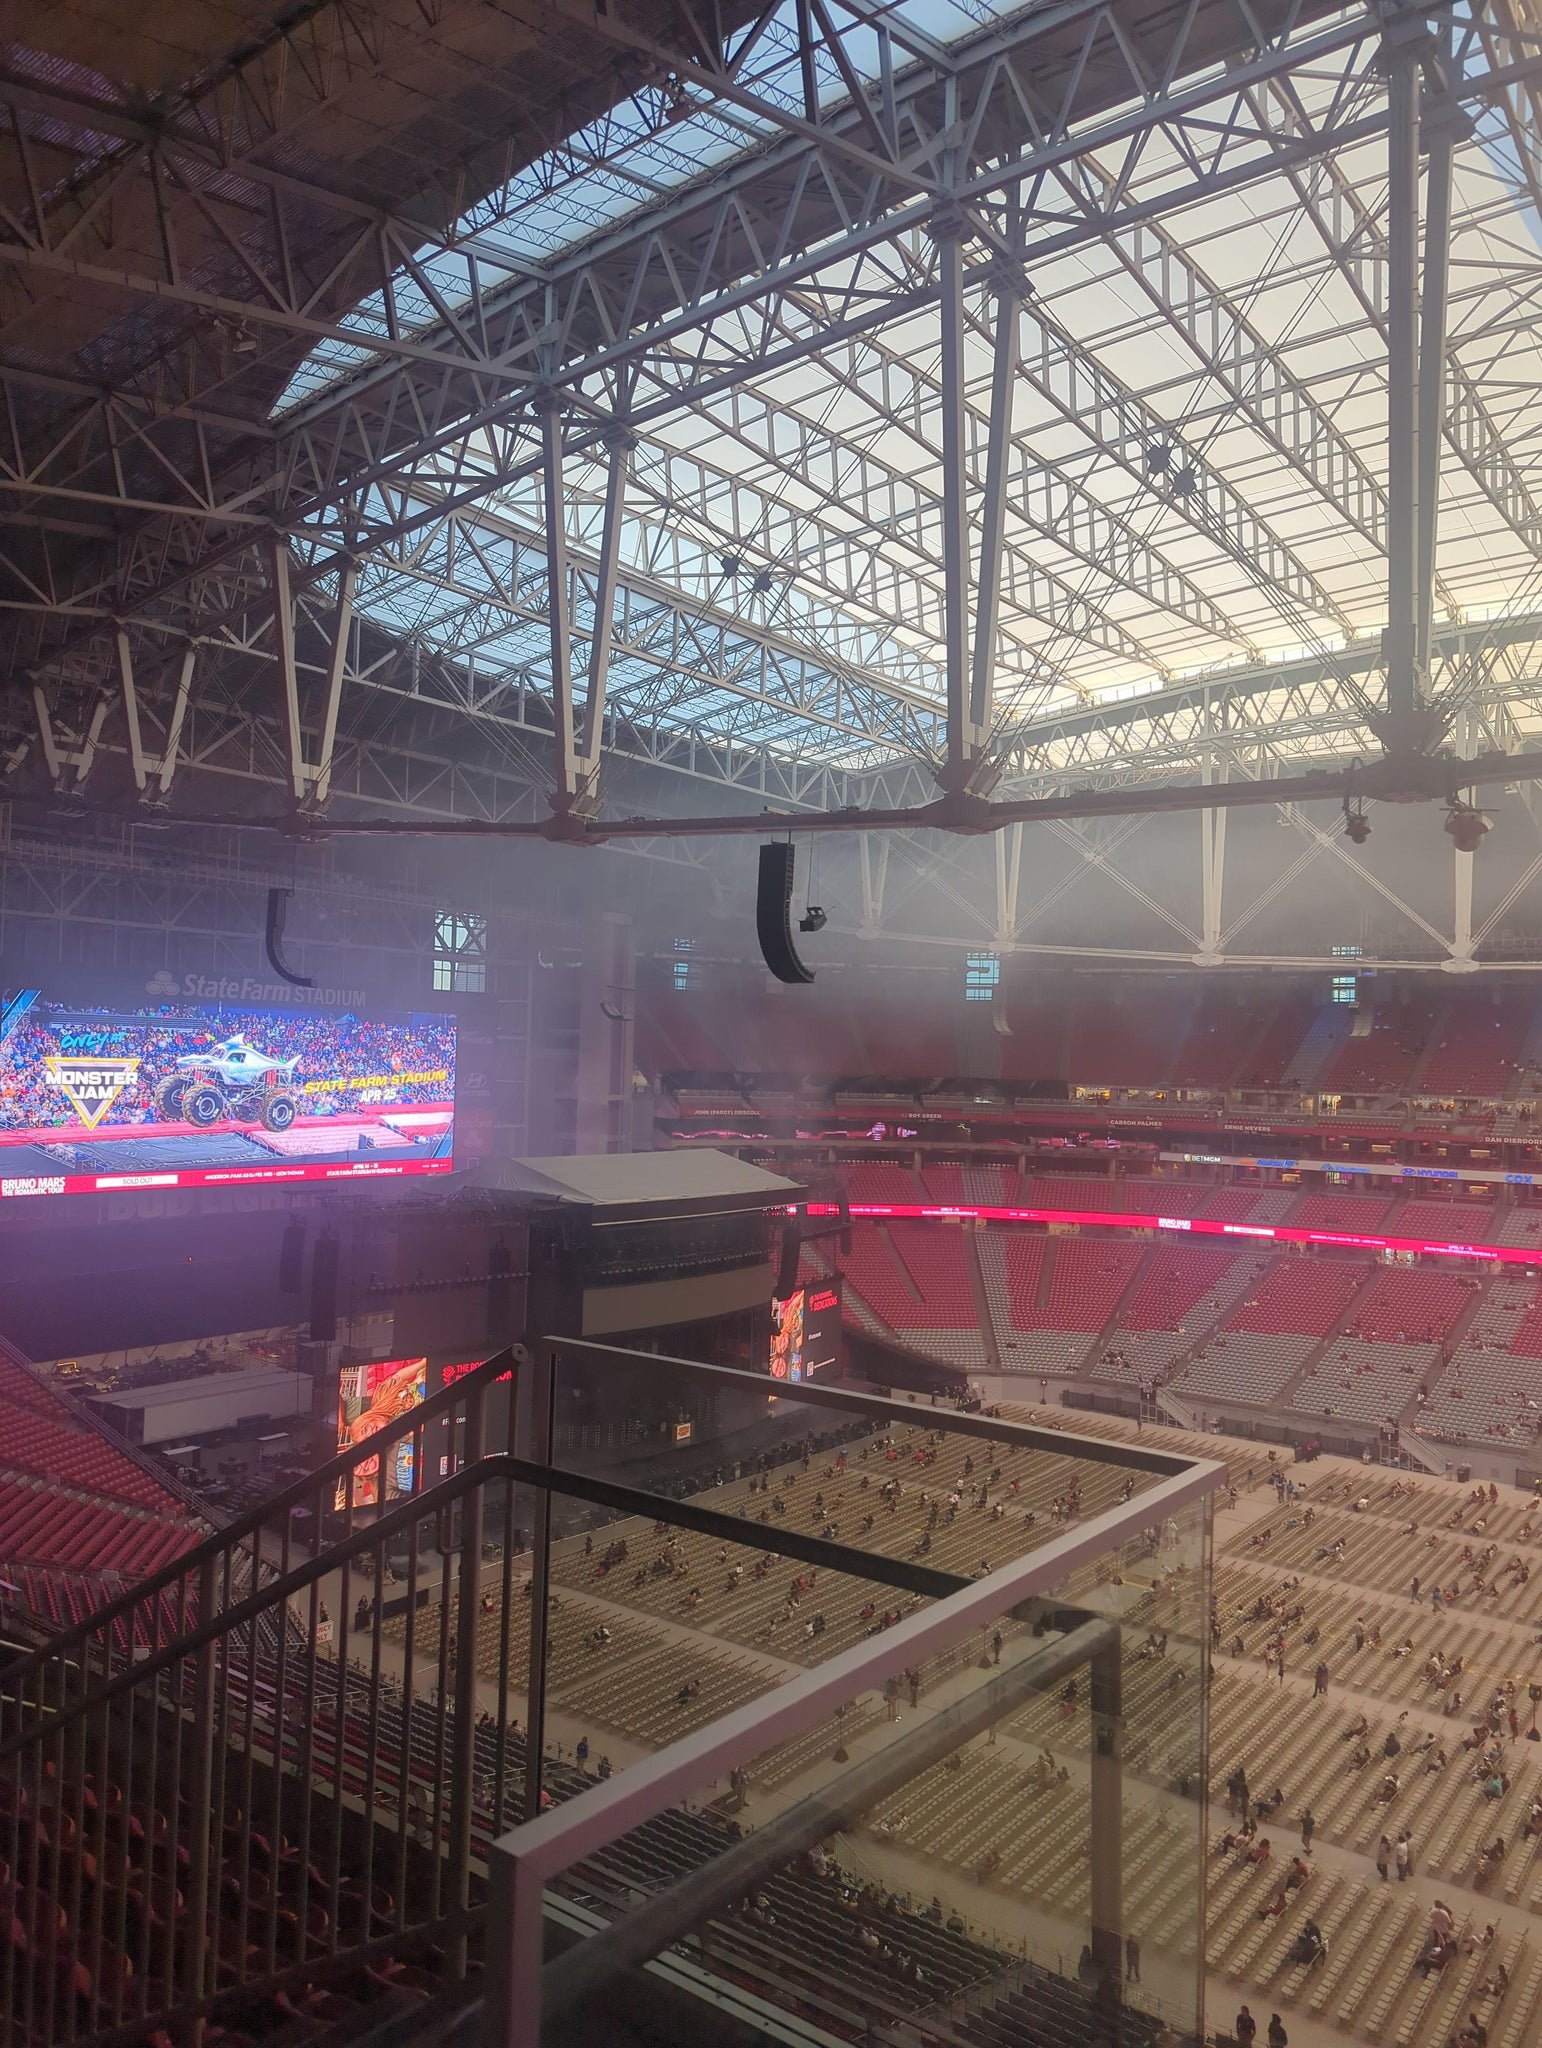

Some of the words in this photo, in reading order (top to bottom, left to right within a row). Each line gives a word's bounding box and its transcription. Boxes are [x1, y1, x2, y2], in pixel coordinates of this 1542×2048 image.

[294, 988, 366, 1007] STADIUM
[60, 1032, 109, 1049] ONLY
[45, 1071, 138, 1085] MONSTER
[304, 1079, 347, 1094] STATE
[350, 1075, 387, 1089] FARM
[391, 1070, 448, 1084] STADIUM
[72, 1086, 115, 1100] JAM
[360, 1090, 379, 1102] APR
[382, 1087, 397, 1099] 25
[1417, 1168, 1458, 1178] HYUNDAI
[1505, 1174, 1533, 1184] COX
[2, 1177, 36, 1190] BRUNO
[38, 1176, 65, 1188] MARS
[15, 1187, 47, 1196] ROMANTIC
[48, 1186, 65, 1194] TOUR
[457, 1364, 470, 1373] THE
